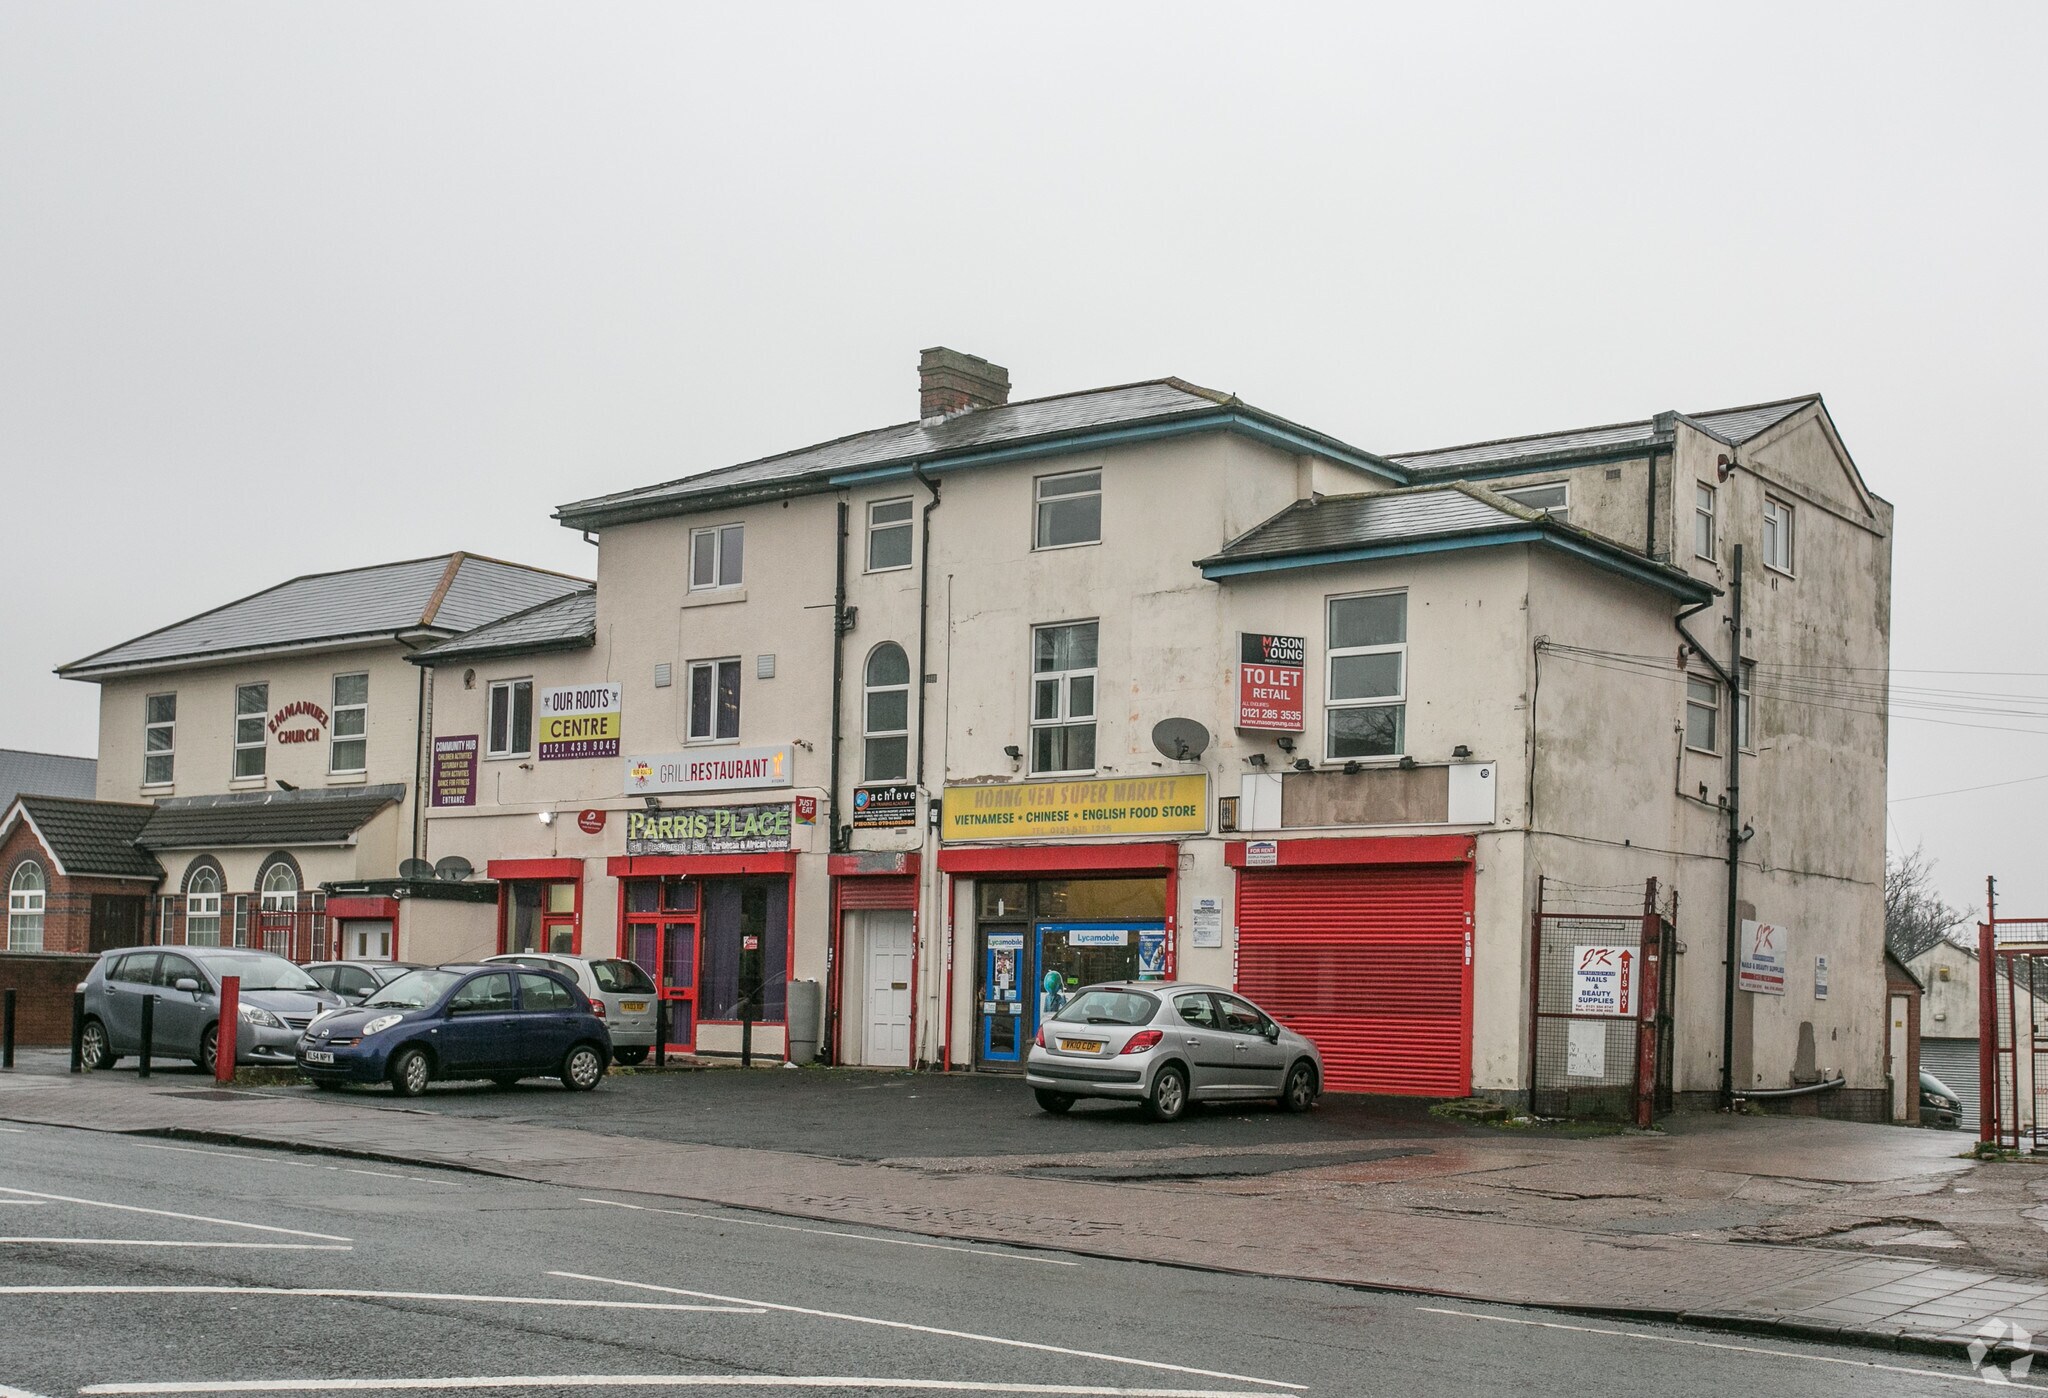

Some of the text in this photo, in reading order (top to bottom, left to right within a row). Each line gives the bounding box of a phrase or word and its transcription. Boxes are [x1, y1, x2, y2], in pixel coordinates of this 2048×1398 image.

[1262, 636, 1303, 649] MASON
[1264, 647, 1303, 660] YOUNG
[1244, 668, 1300, 686] TO LET
[553, 688, 609, 712] OUR ROOTS
[1253, 688, 1290, 700] RETAIL
[268, 701, 329, 734] EMMANUEL
[1242, 708, 1302, 720] 0121 285 3535
[550, 717, 608, 738] CENTRE
[1242, 719, 1301, 728] www.masonyoung.co.uk
[278, 728, 320, 744] CHURCH
[436, 740, 476, 752] COMMUNITY HUB
[543, 740, 616, 754] 0121 439 9045
[442, 796, 466, 804] ENTRANCE
[871, 789, 916, 802] achieve
[975, 780, 1176, 808] HOANG YEN SUPER MARKET
[799, 798, 814, 806] JUST
[955, 805, 1196, 826] VIETNAMESE CHINESE ENGLISH FOOD STORE
[629, 810, 790, 840] PARRIS PLACE
[712, 842, 740, 850] Caribbean
[746, 840, 766, 849] African
[768, 840, 788, 848] Cuisine
[989, 938, 1022, 946] Lycamobile
[1078, 934, 1120, 943] Lycamobile
[1580, 948, 1616, 970] JK
[1620, 990, 1628, 1008] WAY
[1066, 1041, 1080, 1050] VK10
